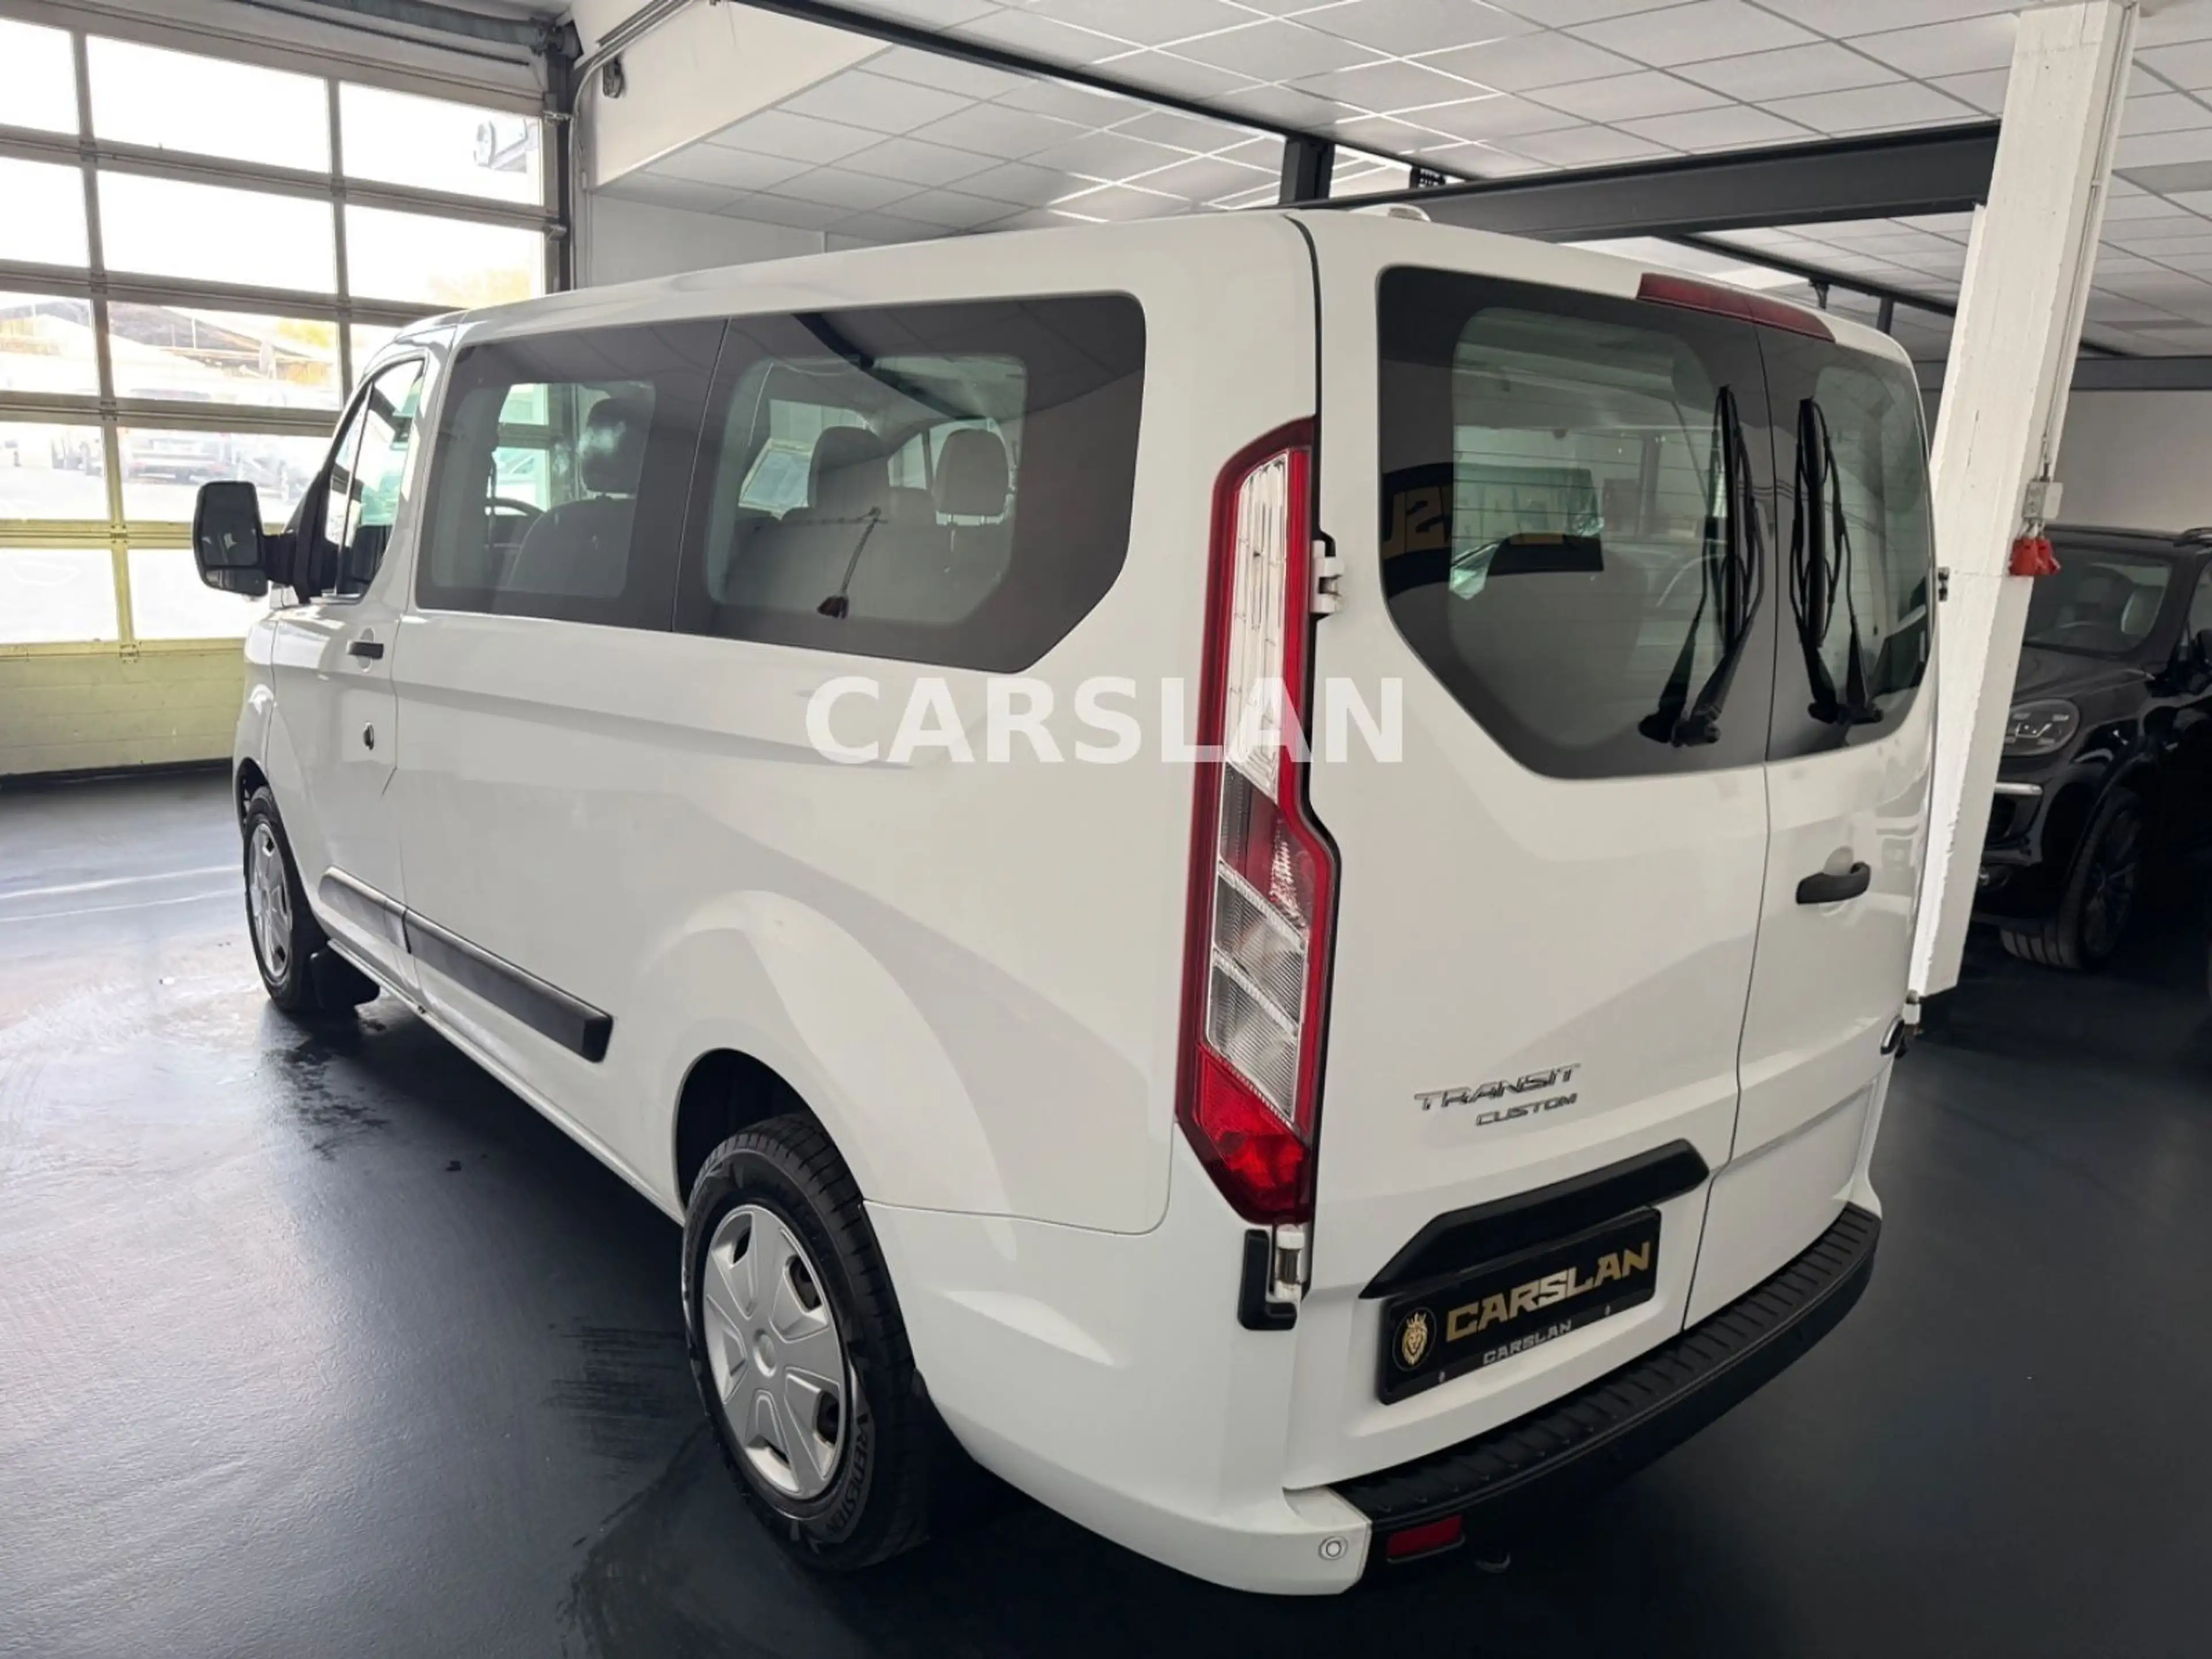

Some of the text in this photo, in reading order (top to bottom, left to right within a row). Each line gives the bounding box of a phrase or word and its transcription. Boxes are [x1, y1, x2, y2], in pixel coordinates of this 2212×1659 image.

[1414, 1063, 1581, 1111] TRANSIT
[1476, 1093, 1578, 1126] CUSTOM
[1446, 1241, 1651, 1342] CARSLAN
[1482, 1319, 1573, 1366] CARSLAN
